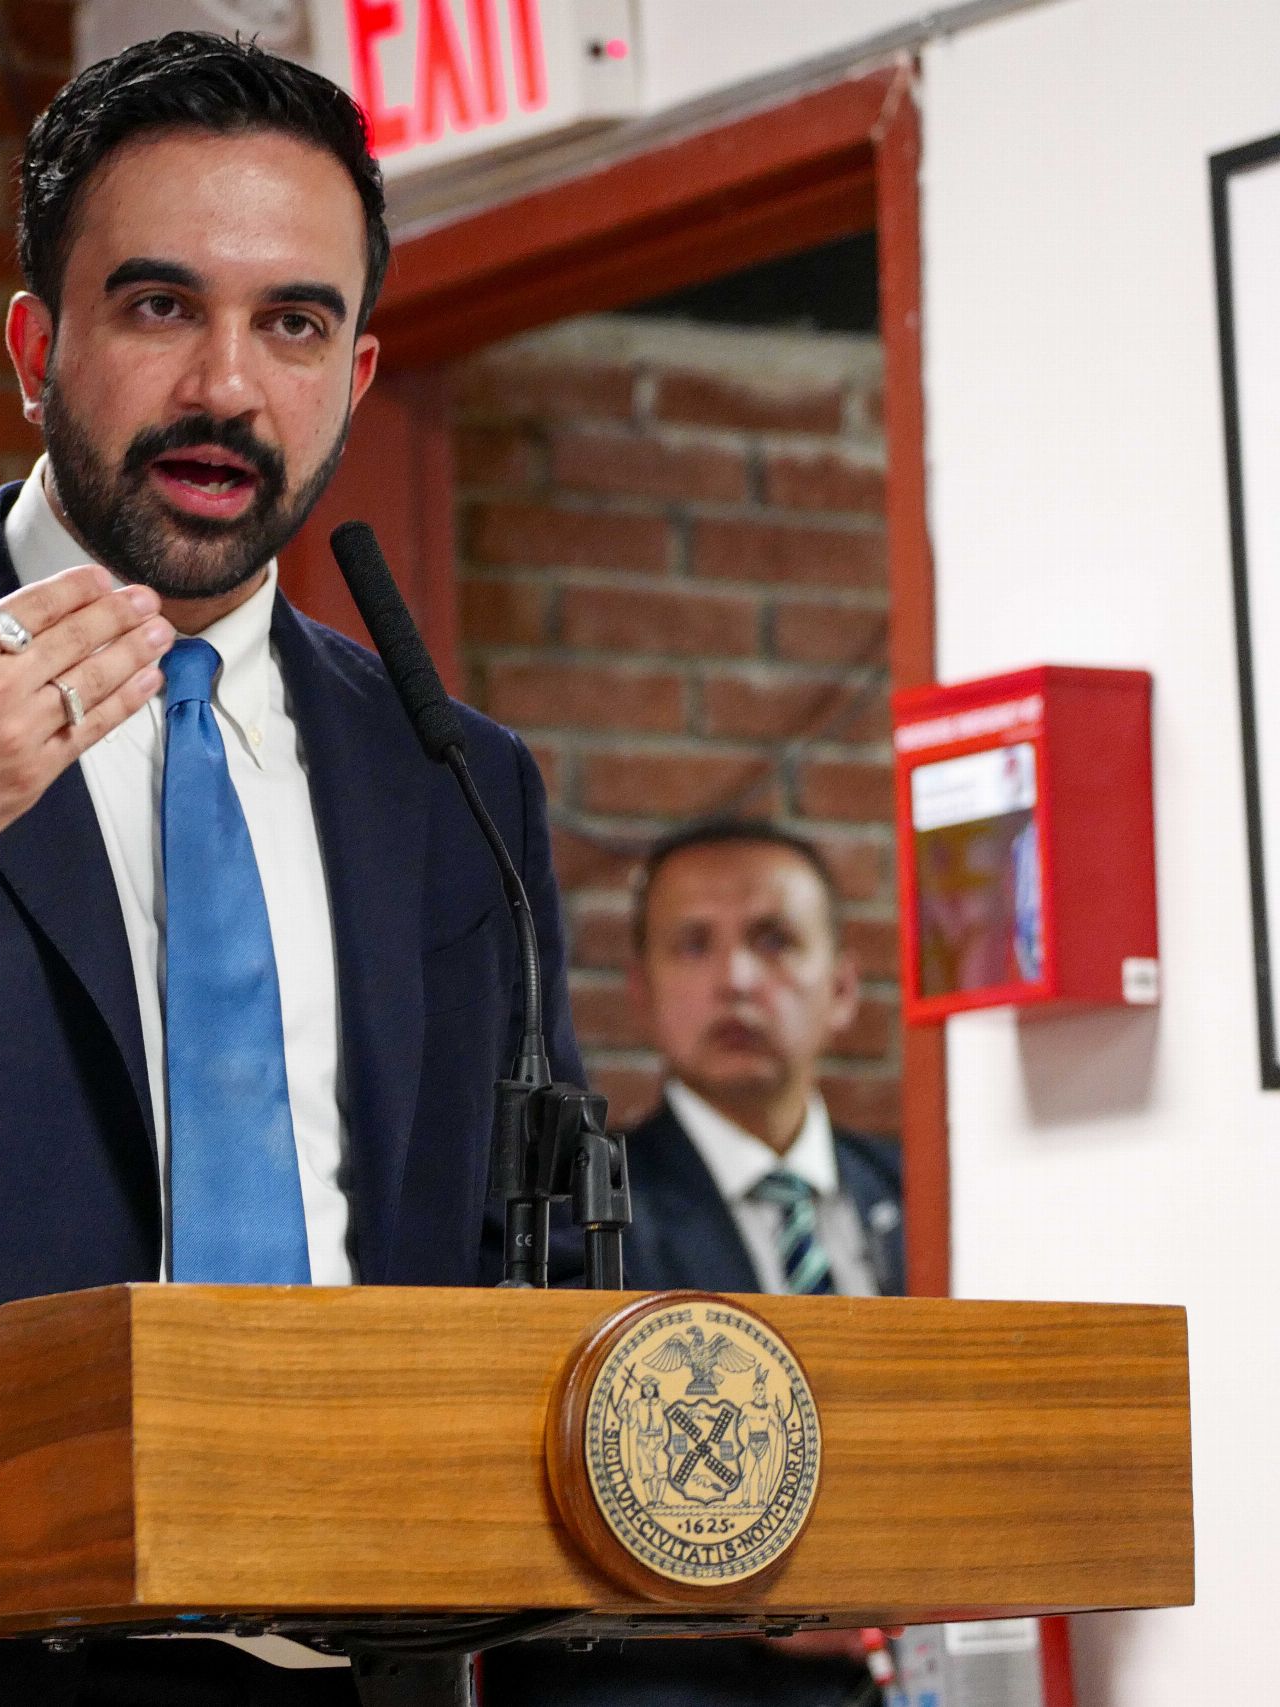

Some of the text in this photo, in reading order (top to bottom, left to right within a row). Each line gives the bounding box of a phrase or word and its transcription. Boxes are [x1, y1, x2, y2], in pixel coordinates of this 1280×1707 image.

[515, 1233, 533, 1247] CE
[638, 1519, 737, 1566] CIVITATIS
[740, 1507, 782, 1552] NOVI
[773, 1426, 805, 1512] EBORACI
[684, 1517, 730, 1535] 1625
